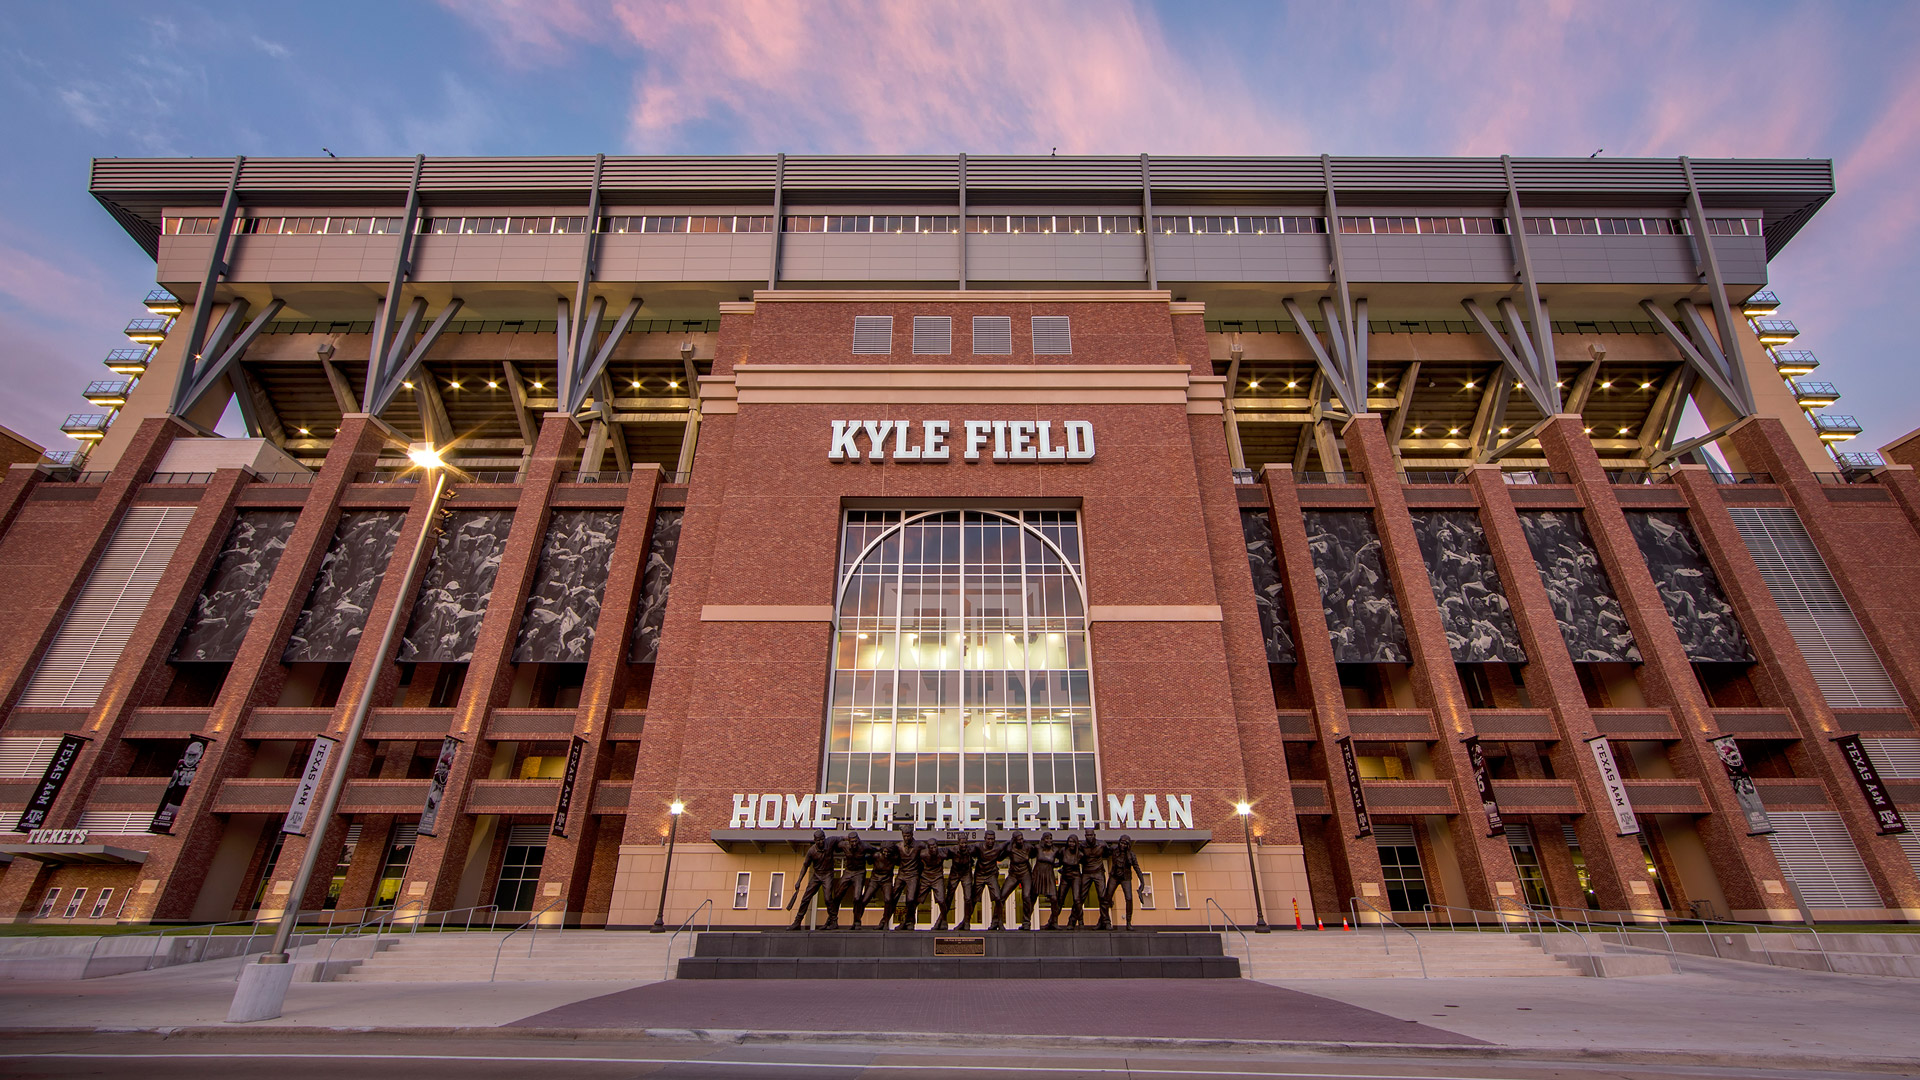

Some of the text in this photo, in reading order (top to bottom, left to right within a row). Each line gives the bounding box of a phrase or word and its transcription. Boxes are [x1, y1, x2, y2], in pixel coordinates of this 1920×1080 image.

[828, 420, 1096, 462] KYLE FIELD
[37, 743, 77, 805] TEXAS A&M
[298, 744, 327, 806] TEXAS A&M
[567, 745, 580, 782] TEXAS
[1344, 745, 1356, 783] TEXAS
[1596, 744, 1625, 807] TEXAS A&M
[1846, 742, 1886, 805] TEXAS A&M
[729, 793, 1194, 829] HOME OF THE 12TH MAN
[27, 829, 88, 844] TICKETS
